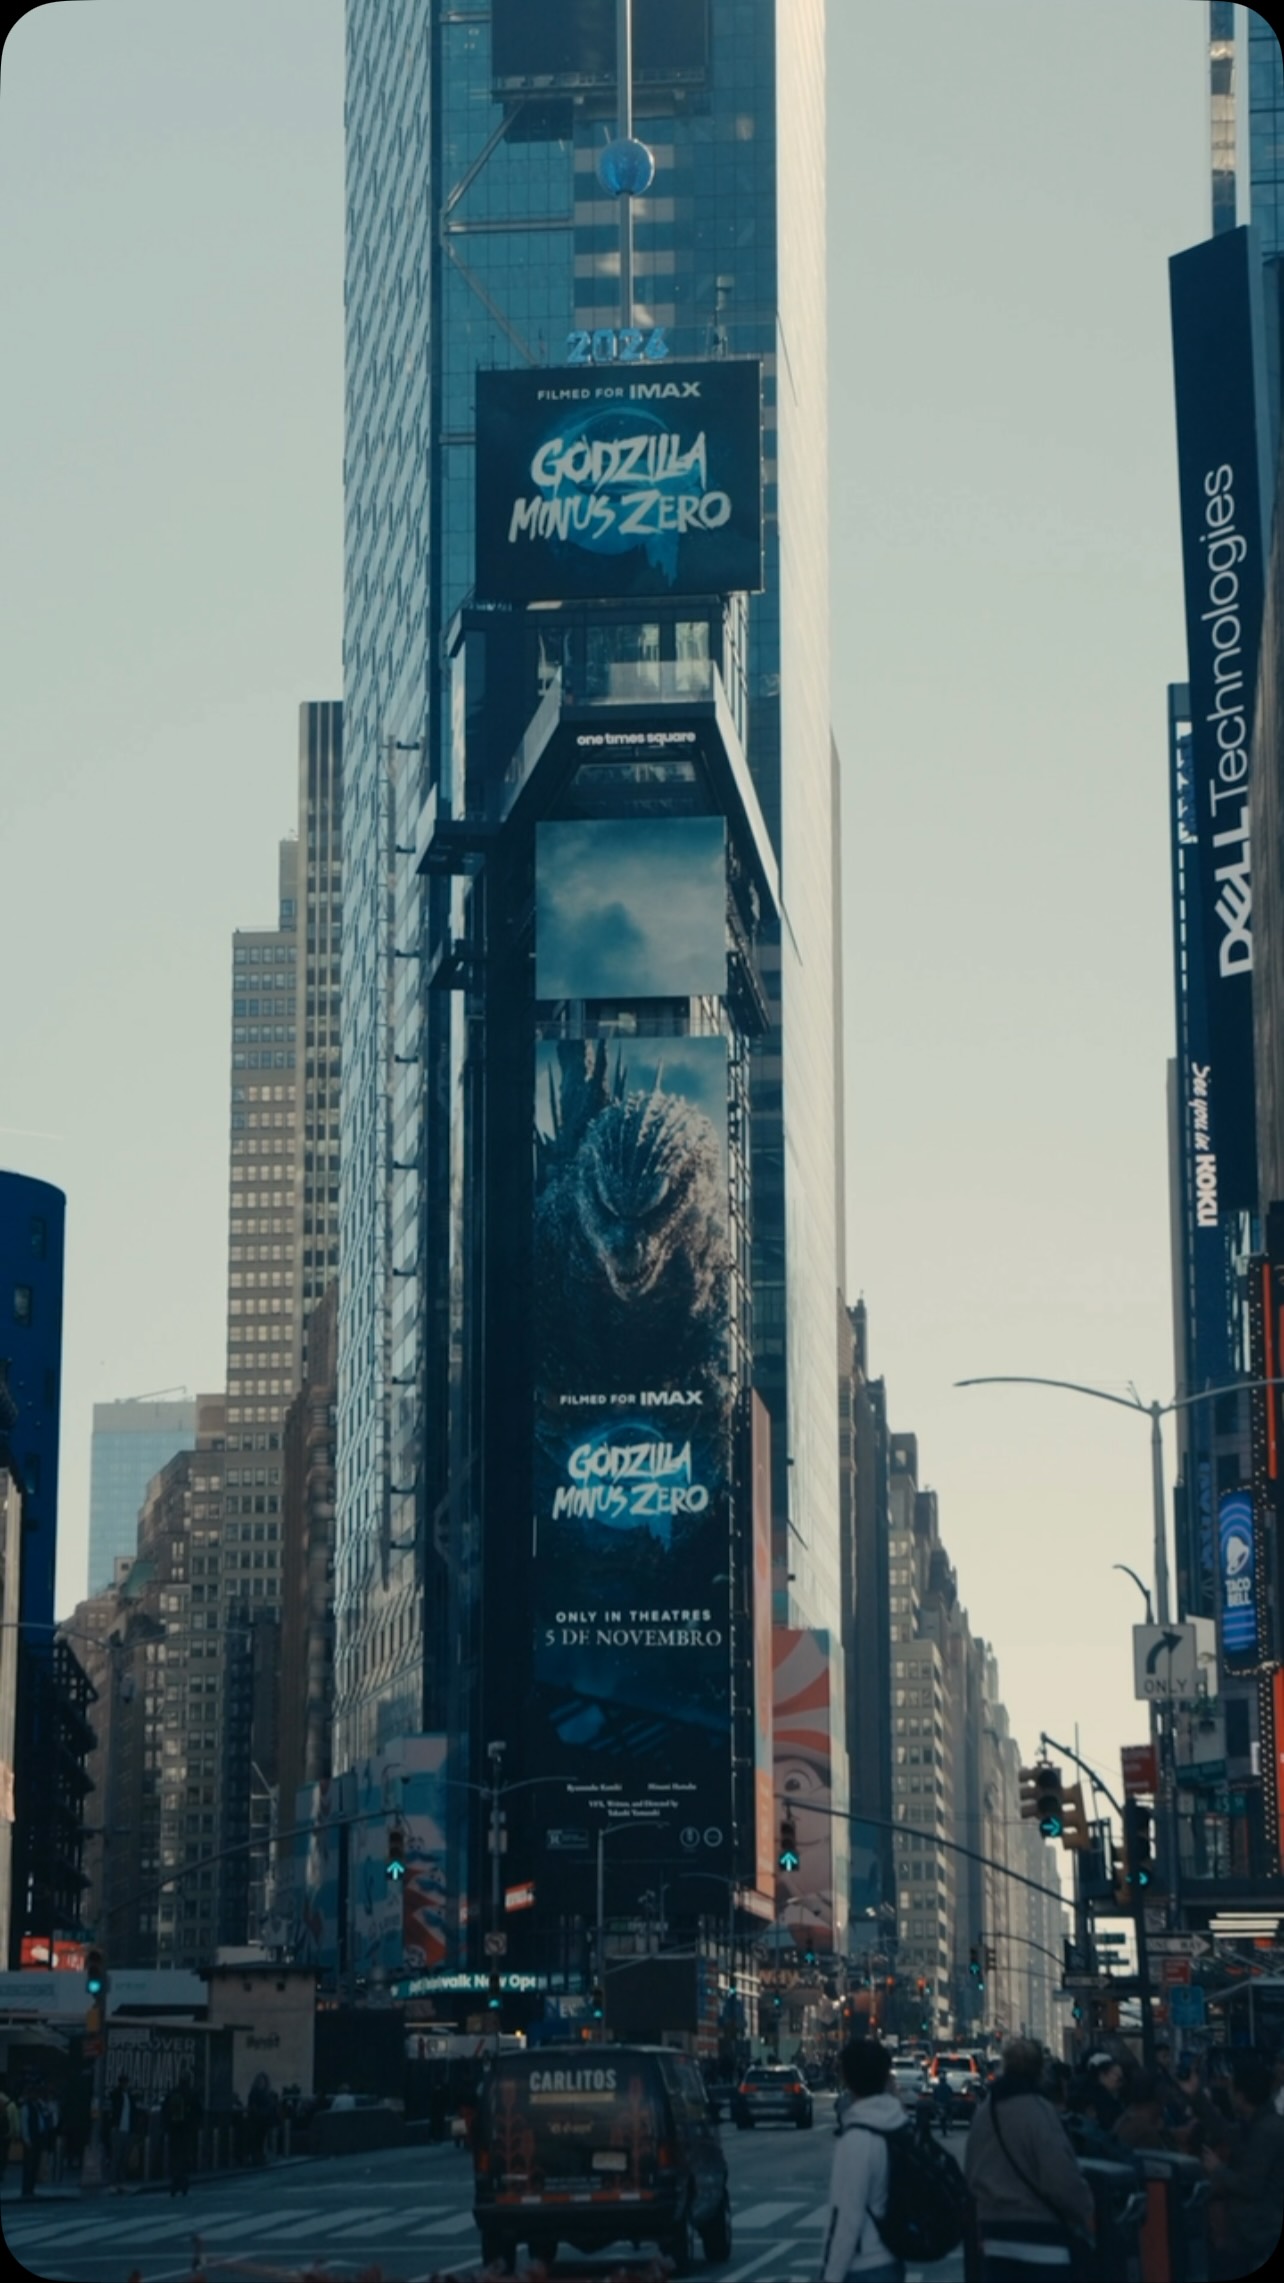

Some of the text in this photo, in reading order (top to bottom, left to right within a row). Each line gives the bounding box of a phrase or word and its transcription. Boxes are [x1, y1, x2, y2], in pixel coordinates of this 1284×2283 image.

[566, 327, 669, 363] 2026
[537, 381, 701, 401] FILMED FOR IMAX
[530, 431, 706, 497] GODZILLA
[508, 490, 732, 542] MINUS ZERO
[1199, 463, 1253, 978] DELL Technologies
[576, 731, 696, 748] one times square
[1188, 1097, 1208, 1131] you
[1195, 1154, 1218, 1227] KOKU
[560, 1390, 703, 1406] FILMED FOR IMAX
[568, 1440, 692, 1486] GODZILLA
[552, 1482, 709, 1520] MINUS ZERO
[556, 1609, 711, 1623] ONLY IN THEATRES
[545, 1629, 722, 1647] 5 DE NOVEMBRO
[1143, 1679, 1188, 1694] ONLY
[529, 2069, 616, 2091] CARLITOS
